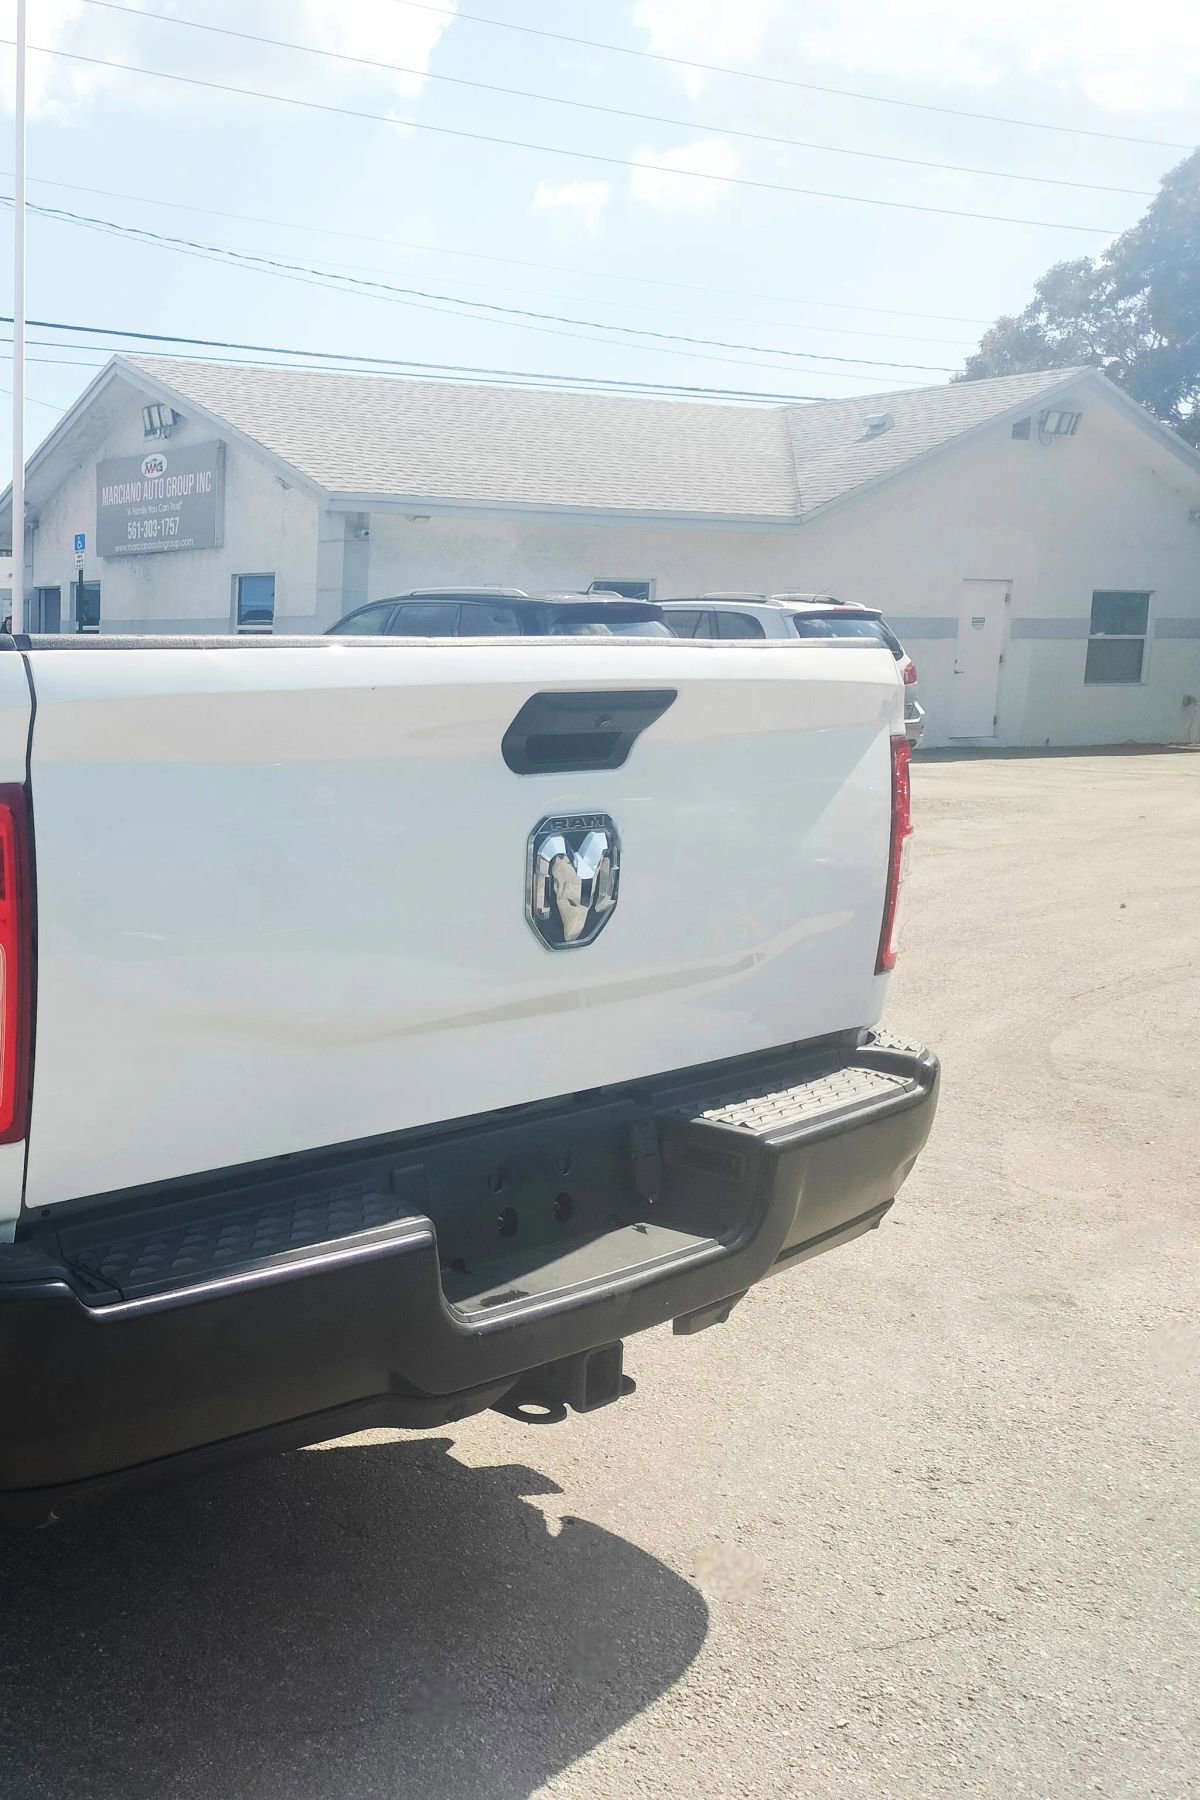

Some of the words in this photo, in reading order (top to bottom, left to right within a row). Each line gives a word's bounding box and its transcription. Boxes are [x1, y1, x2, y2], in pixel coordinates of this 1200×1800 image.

[102, 482, 141, 506] MARCIANO
[142, 479, 164, 501] AUTO
[166, 474, 195, 498] GROUP
[196, 471, 212, 494] INC
[158, 502, 170, 513] Can
[127, 517, 180, 540] 561-303-1757
[551, 815, 605, 830] RAM
